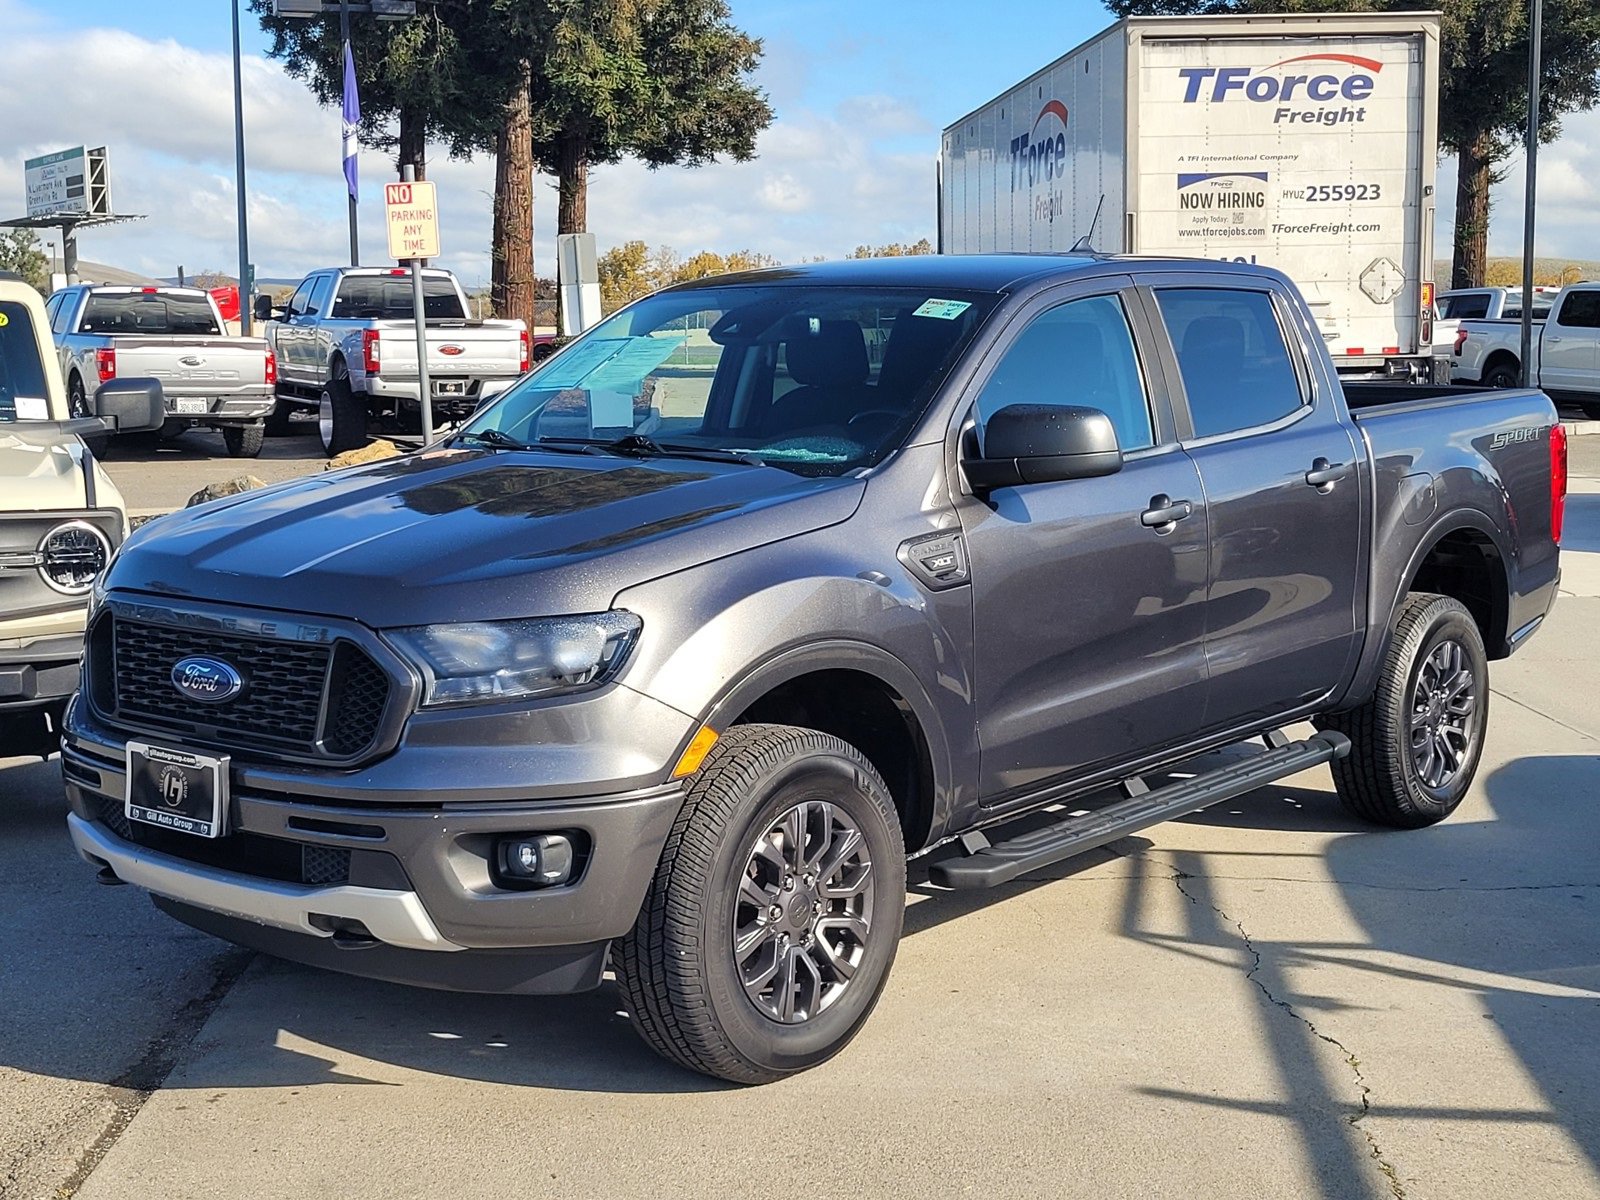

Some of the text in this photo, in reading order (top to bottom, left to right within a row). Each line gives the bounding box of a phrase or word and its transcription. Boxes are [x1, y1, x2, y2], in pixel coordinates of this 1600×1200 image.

[1178, 67, 1374, 103] TForce
[1273, 107, 1366, 127] Freight
[1010, 132, 1066, 194] TForce
[1259, 153, 1299, 161] Company
[389, 186, 411, 203] NO
[1180, 191, 1265, 209] NOW HIRING
[1282, 184, 1381, 202] HYUZ 255923
[1034, 189, 1063, 223] Freight
[391, 209, 433, 222] PARKING
[1192, 215, 1229, 224] Apply Today:
[403, 224, 423, 236] ANY
[1178, 226, 1266, 238] www.tforcejobs.com
[1271, 222, 1381, 235] TForceFreight.com
[403, 239, 425, 250] TIME
[1489, 427, 1545, 452] SPORT
[931, 555, 954, 568] XLT
[181, 664, 218, 692] Ford
[149, 748, 196, 764] gillautogroup.com
[146, 811, 193, 830] Gill Auto Group
